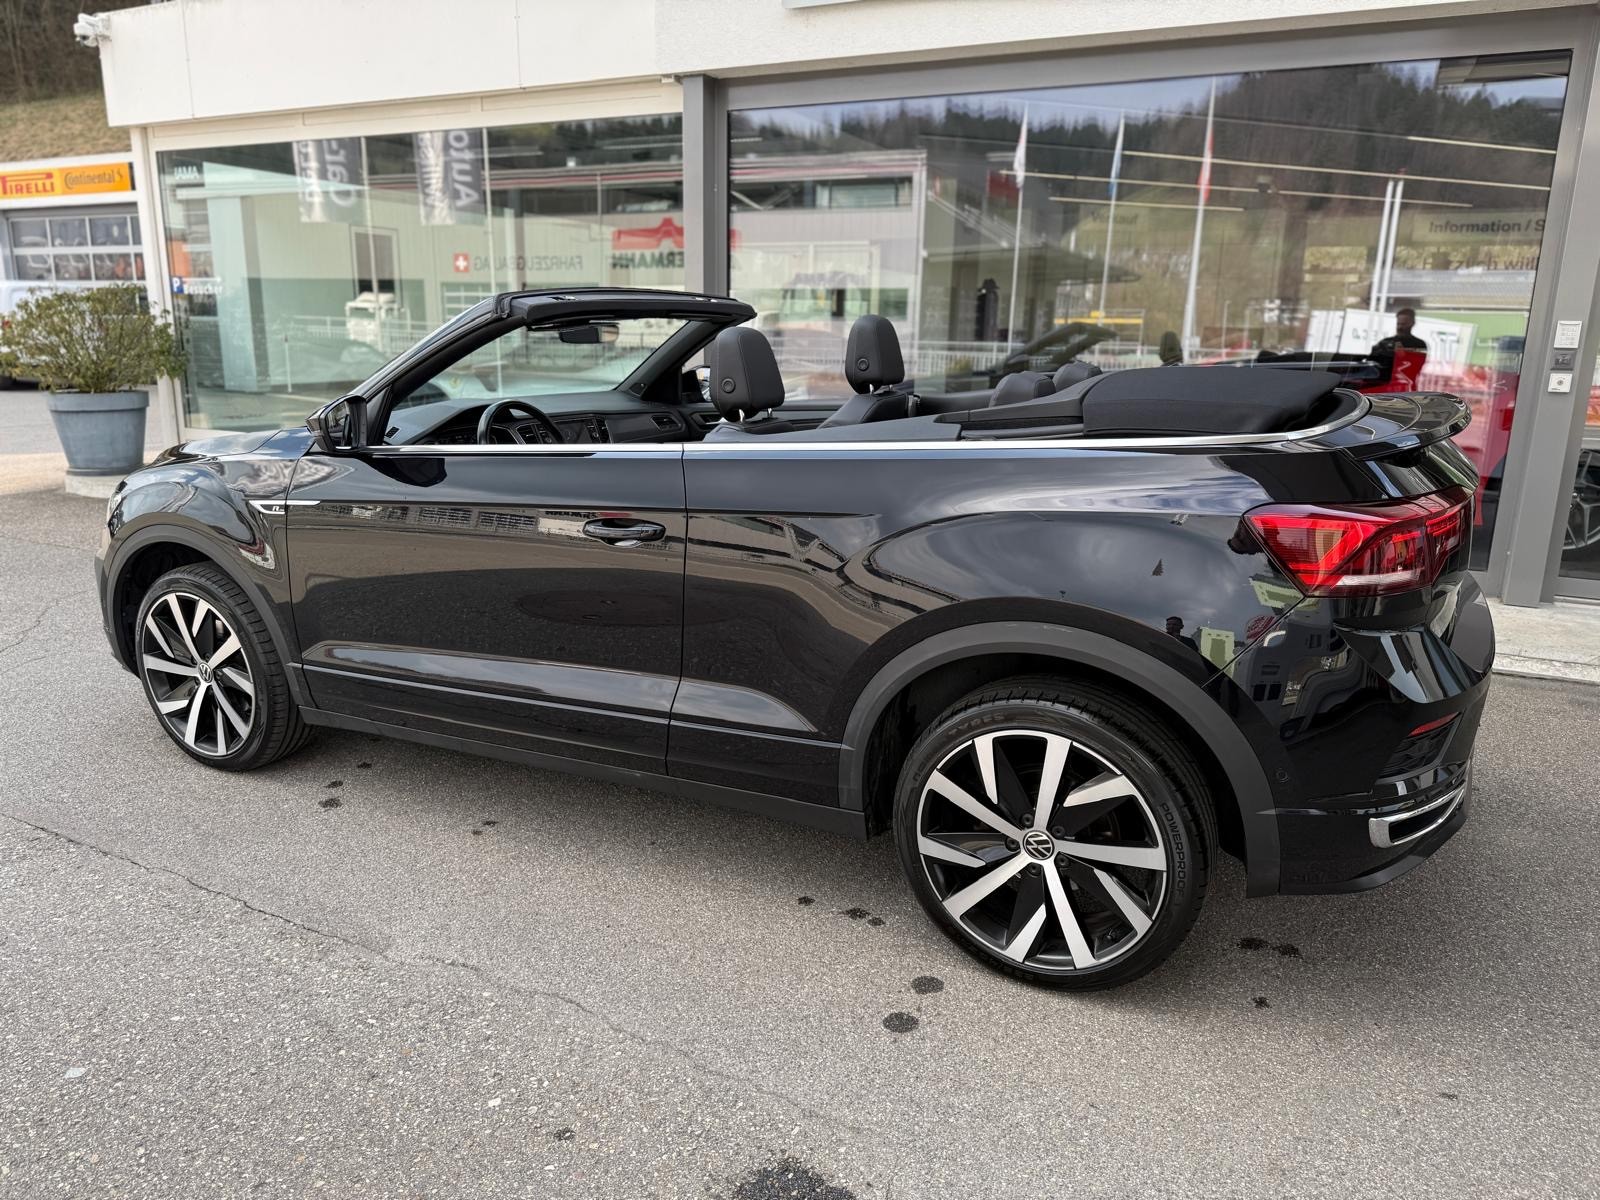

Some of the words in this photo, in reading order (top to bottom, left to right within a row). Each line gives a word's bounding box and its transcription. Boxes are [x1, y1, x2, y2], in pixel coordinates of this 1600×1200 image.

[0, 172, 55, 195] PIRELLI
[64, 169, 115, 190] Continental
[1428, 219, 1521, 233] Information
[1160, 802, 1186, 897] POWERPROOF
